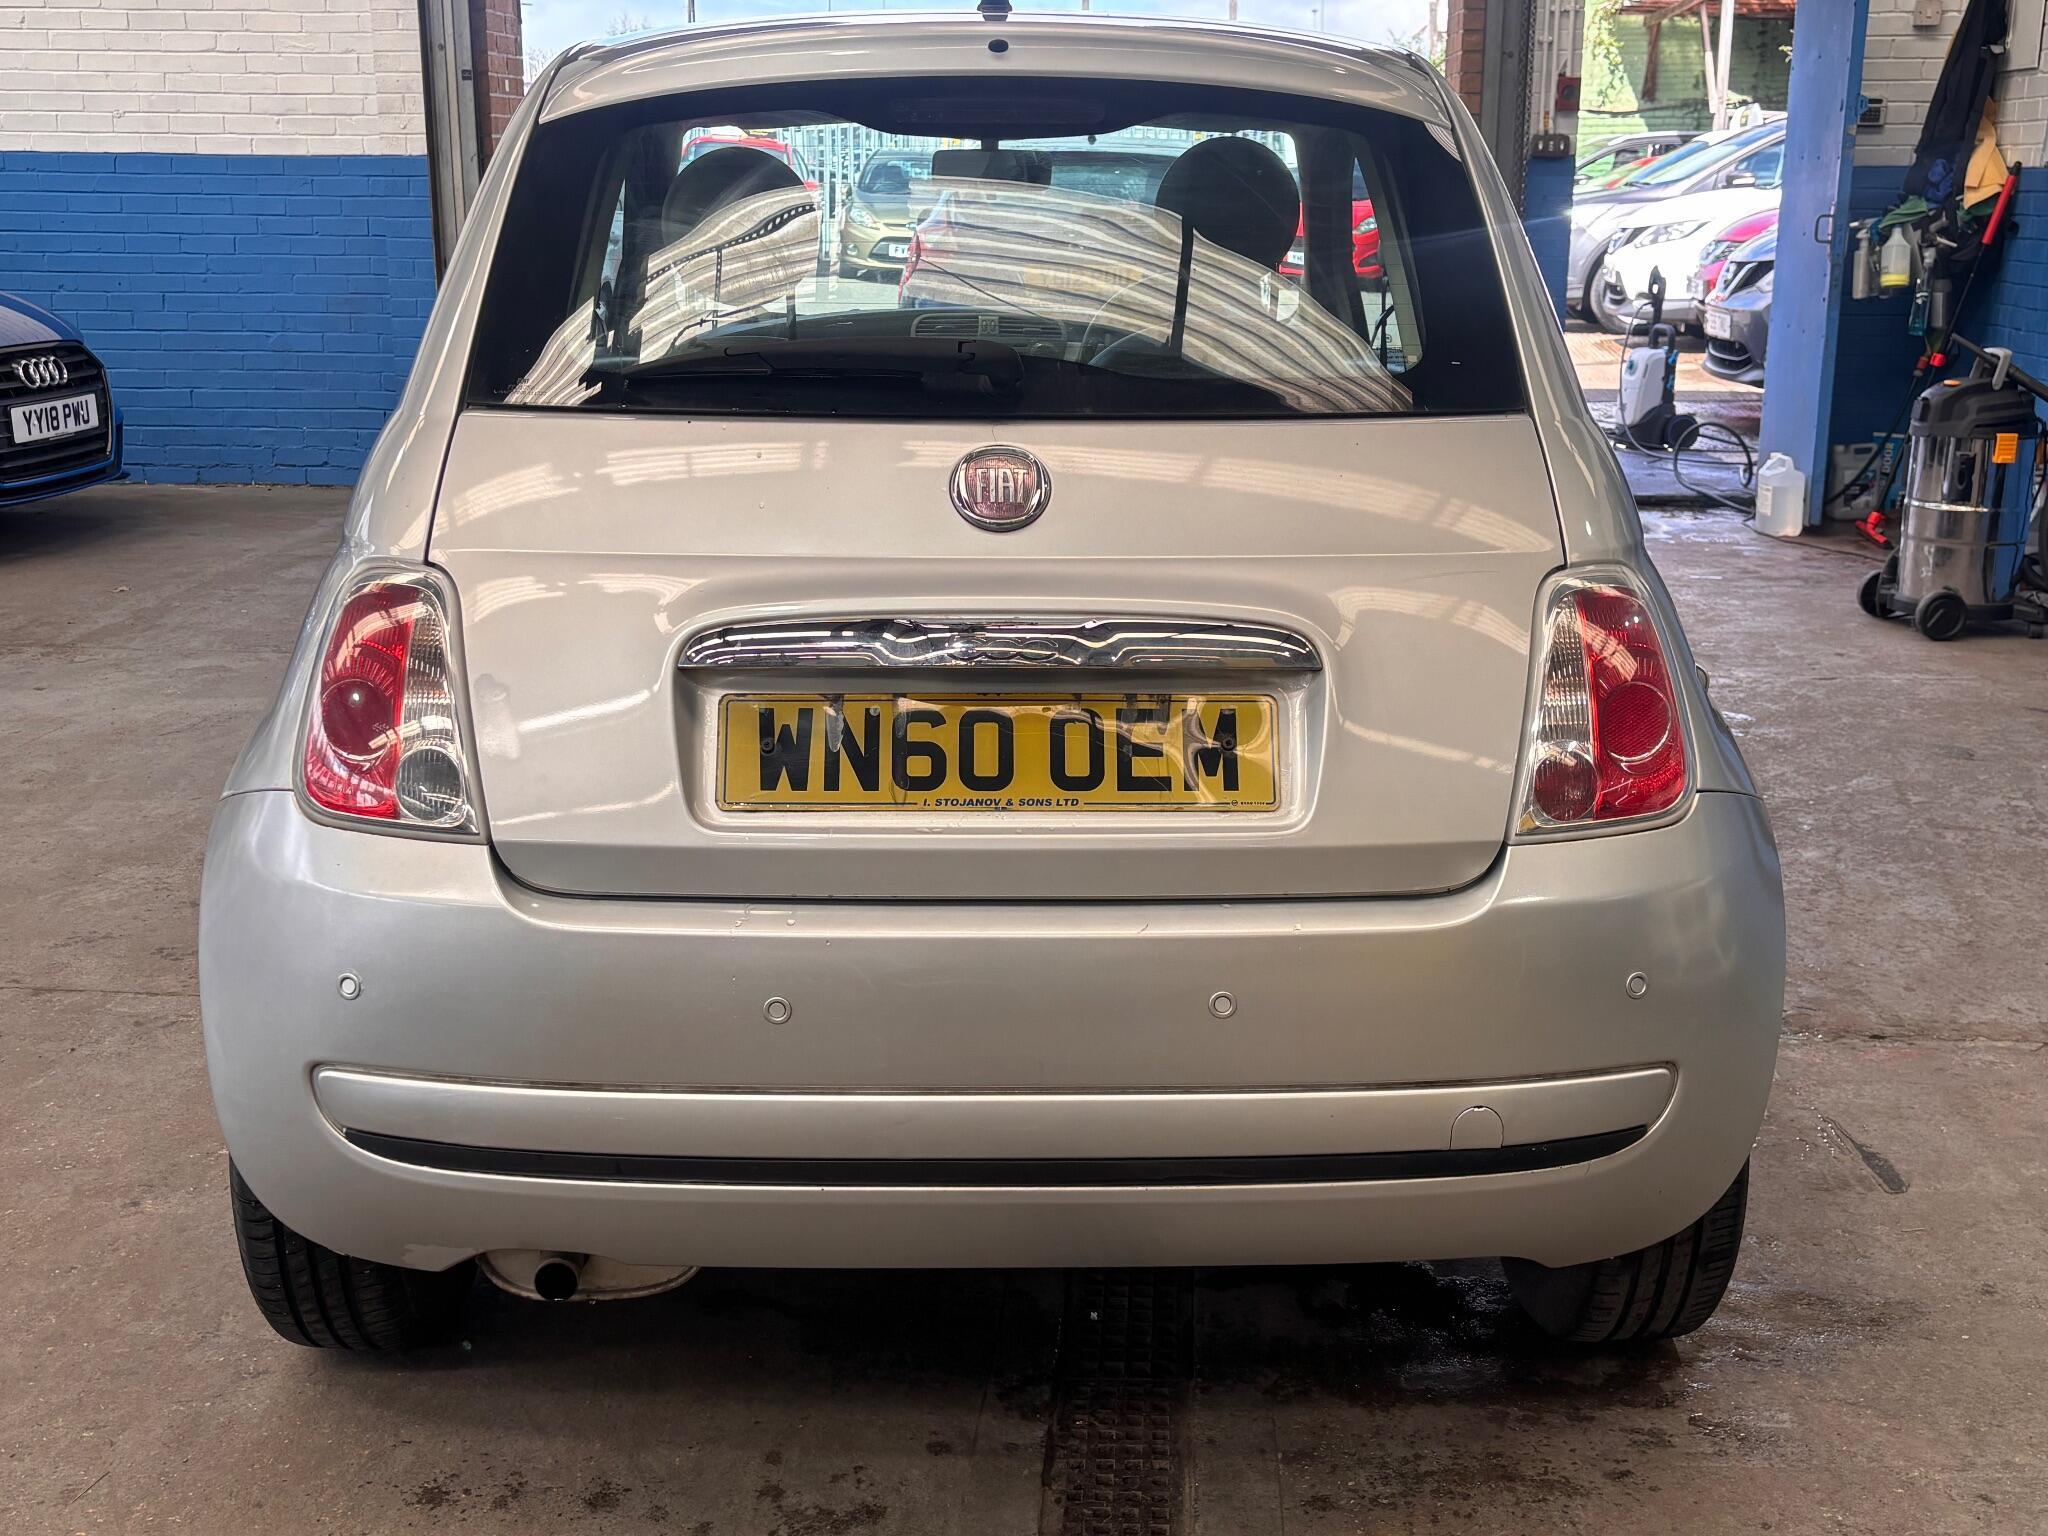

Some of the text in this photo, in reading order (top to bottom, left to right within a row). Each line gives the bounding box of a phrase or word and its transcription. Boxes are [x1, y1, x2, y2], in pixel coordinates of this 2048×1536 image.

[22, 400, 90, 436] YY18 PWU
[976, 468, 1028, 503] FIAT
[760, 707, 1240, 792] WN60 OEM
[934, 798, 1001, 807] STOJANOV
[1005, 798, 1014, 807] &
[1018, 798, 1053, 807] SONS
[1056, 798, 1080, 807] LTD
